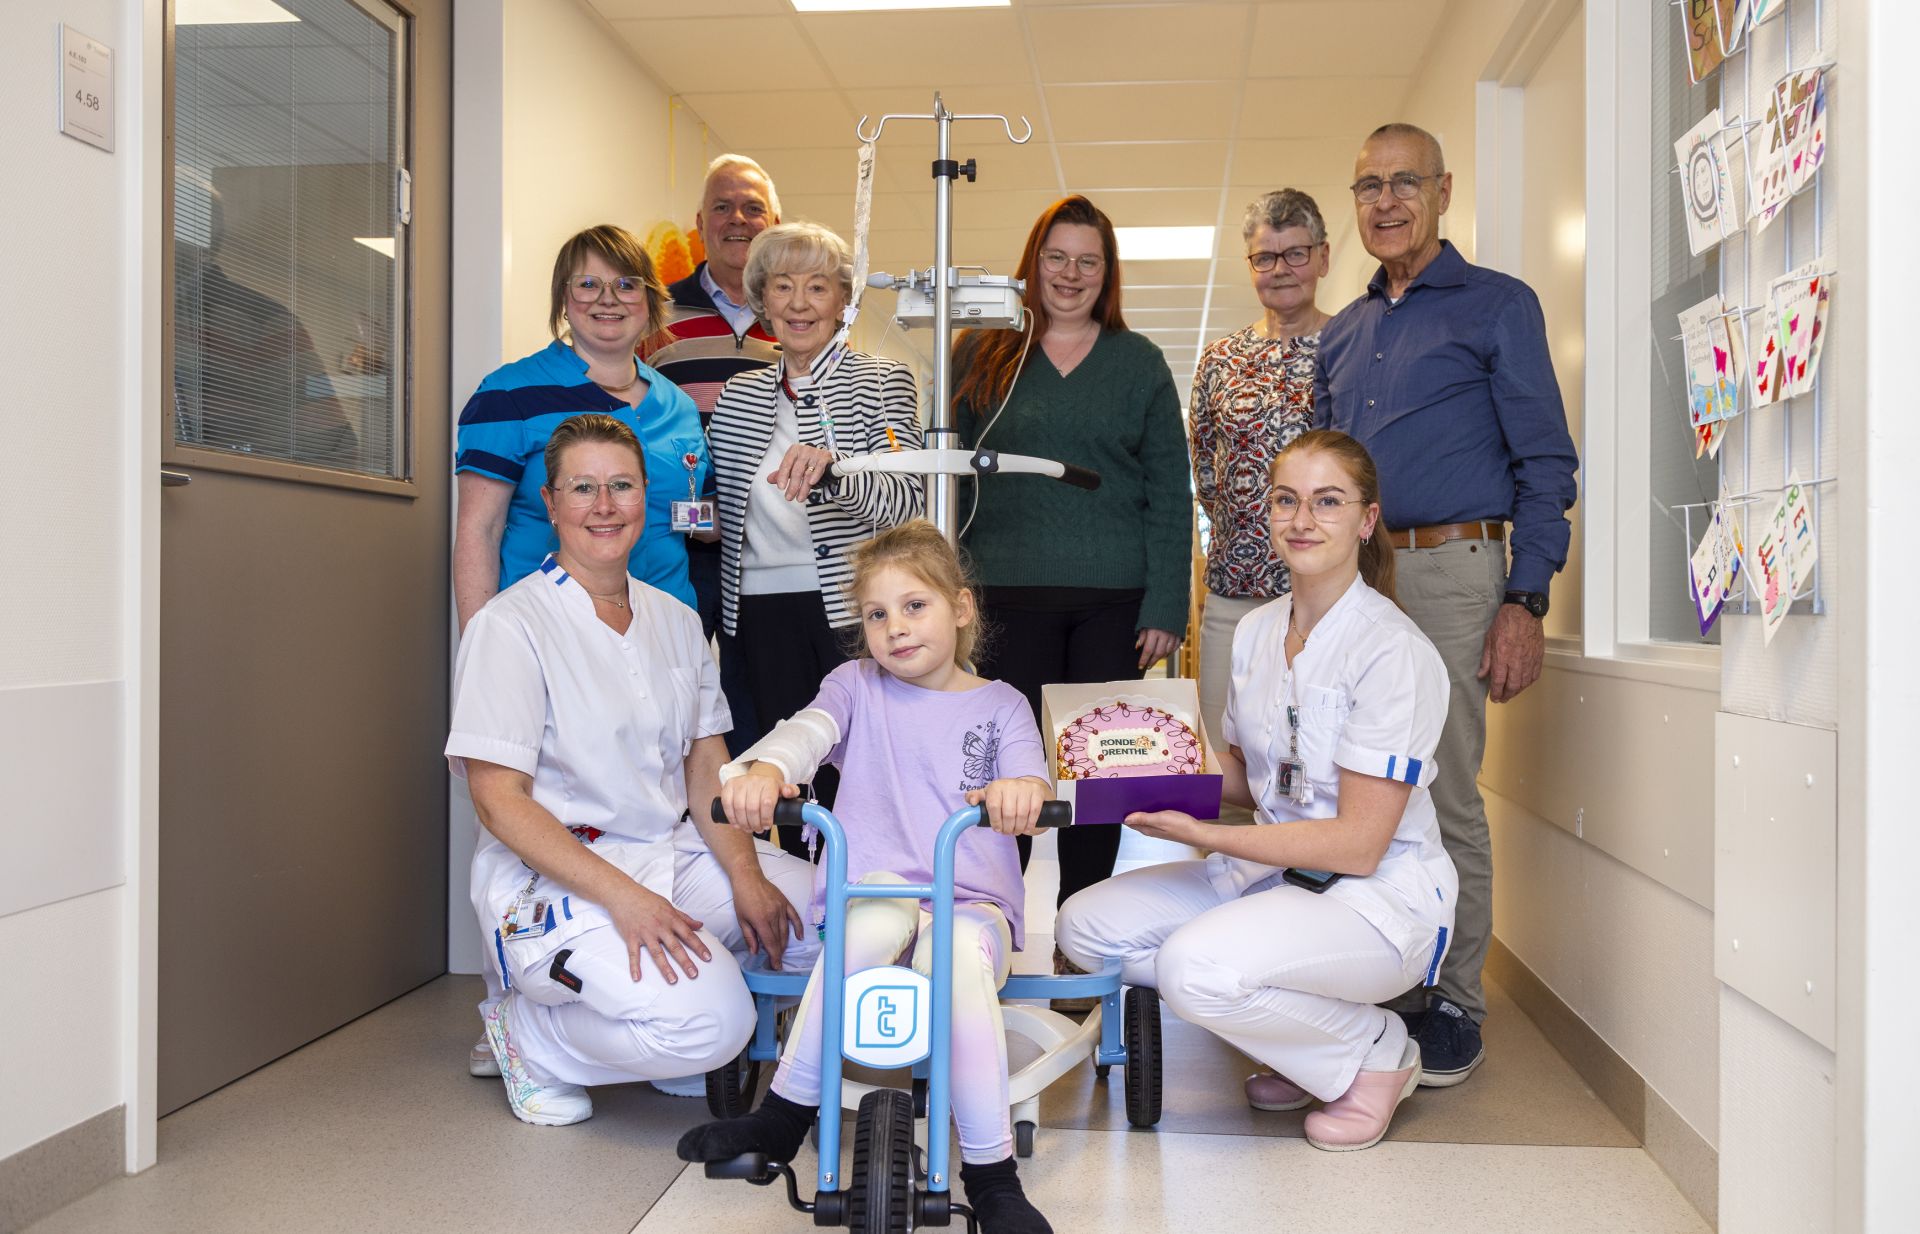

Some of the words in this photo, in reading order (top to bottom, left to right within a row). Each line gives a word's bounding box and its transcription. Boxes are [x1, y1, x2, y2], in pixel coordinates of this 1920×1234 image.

[75, 89, 100, 111] 4.58
[1100, 738, 1136, 747] RONDE
[1102, 748, 1148, 757] DRENTHE
